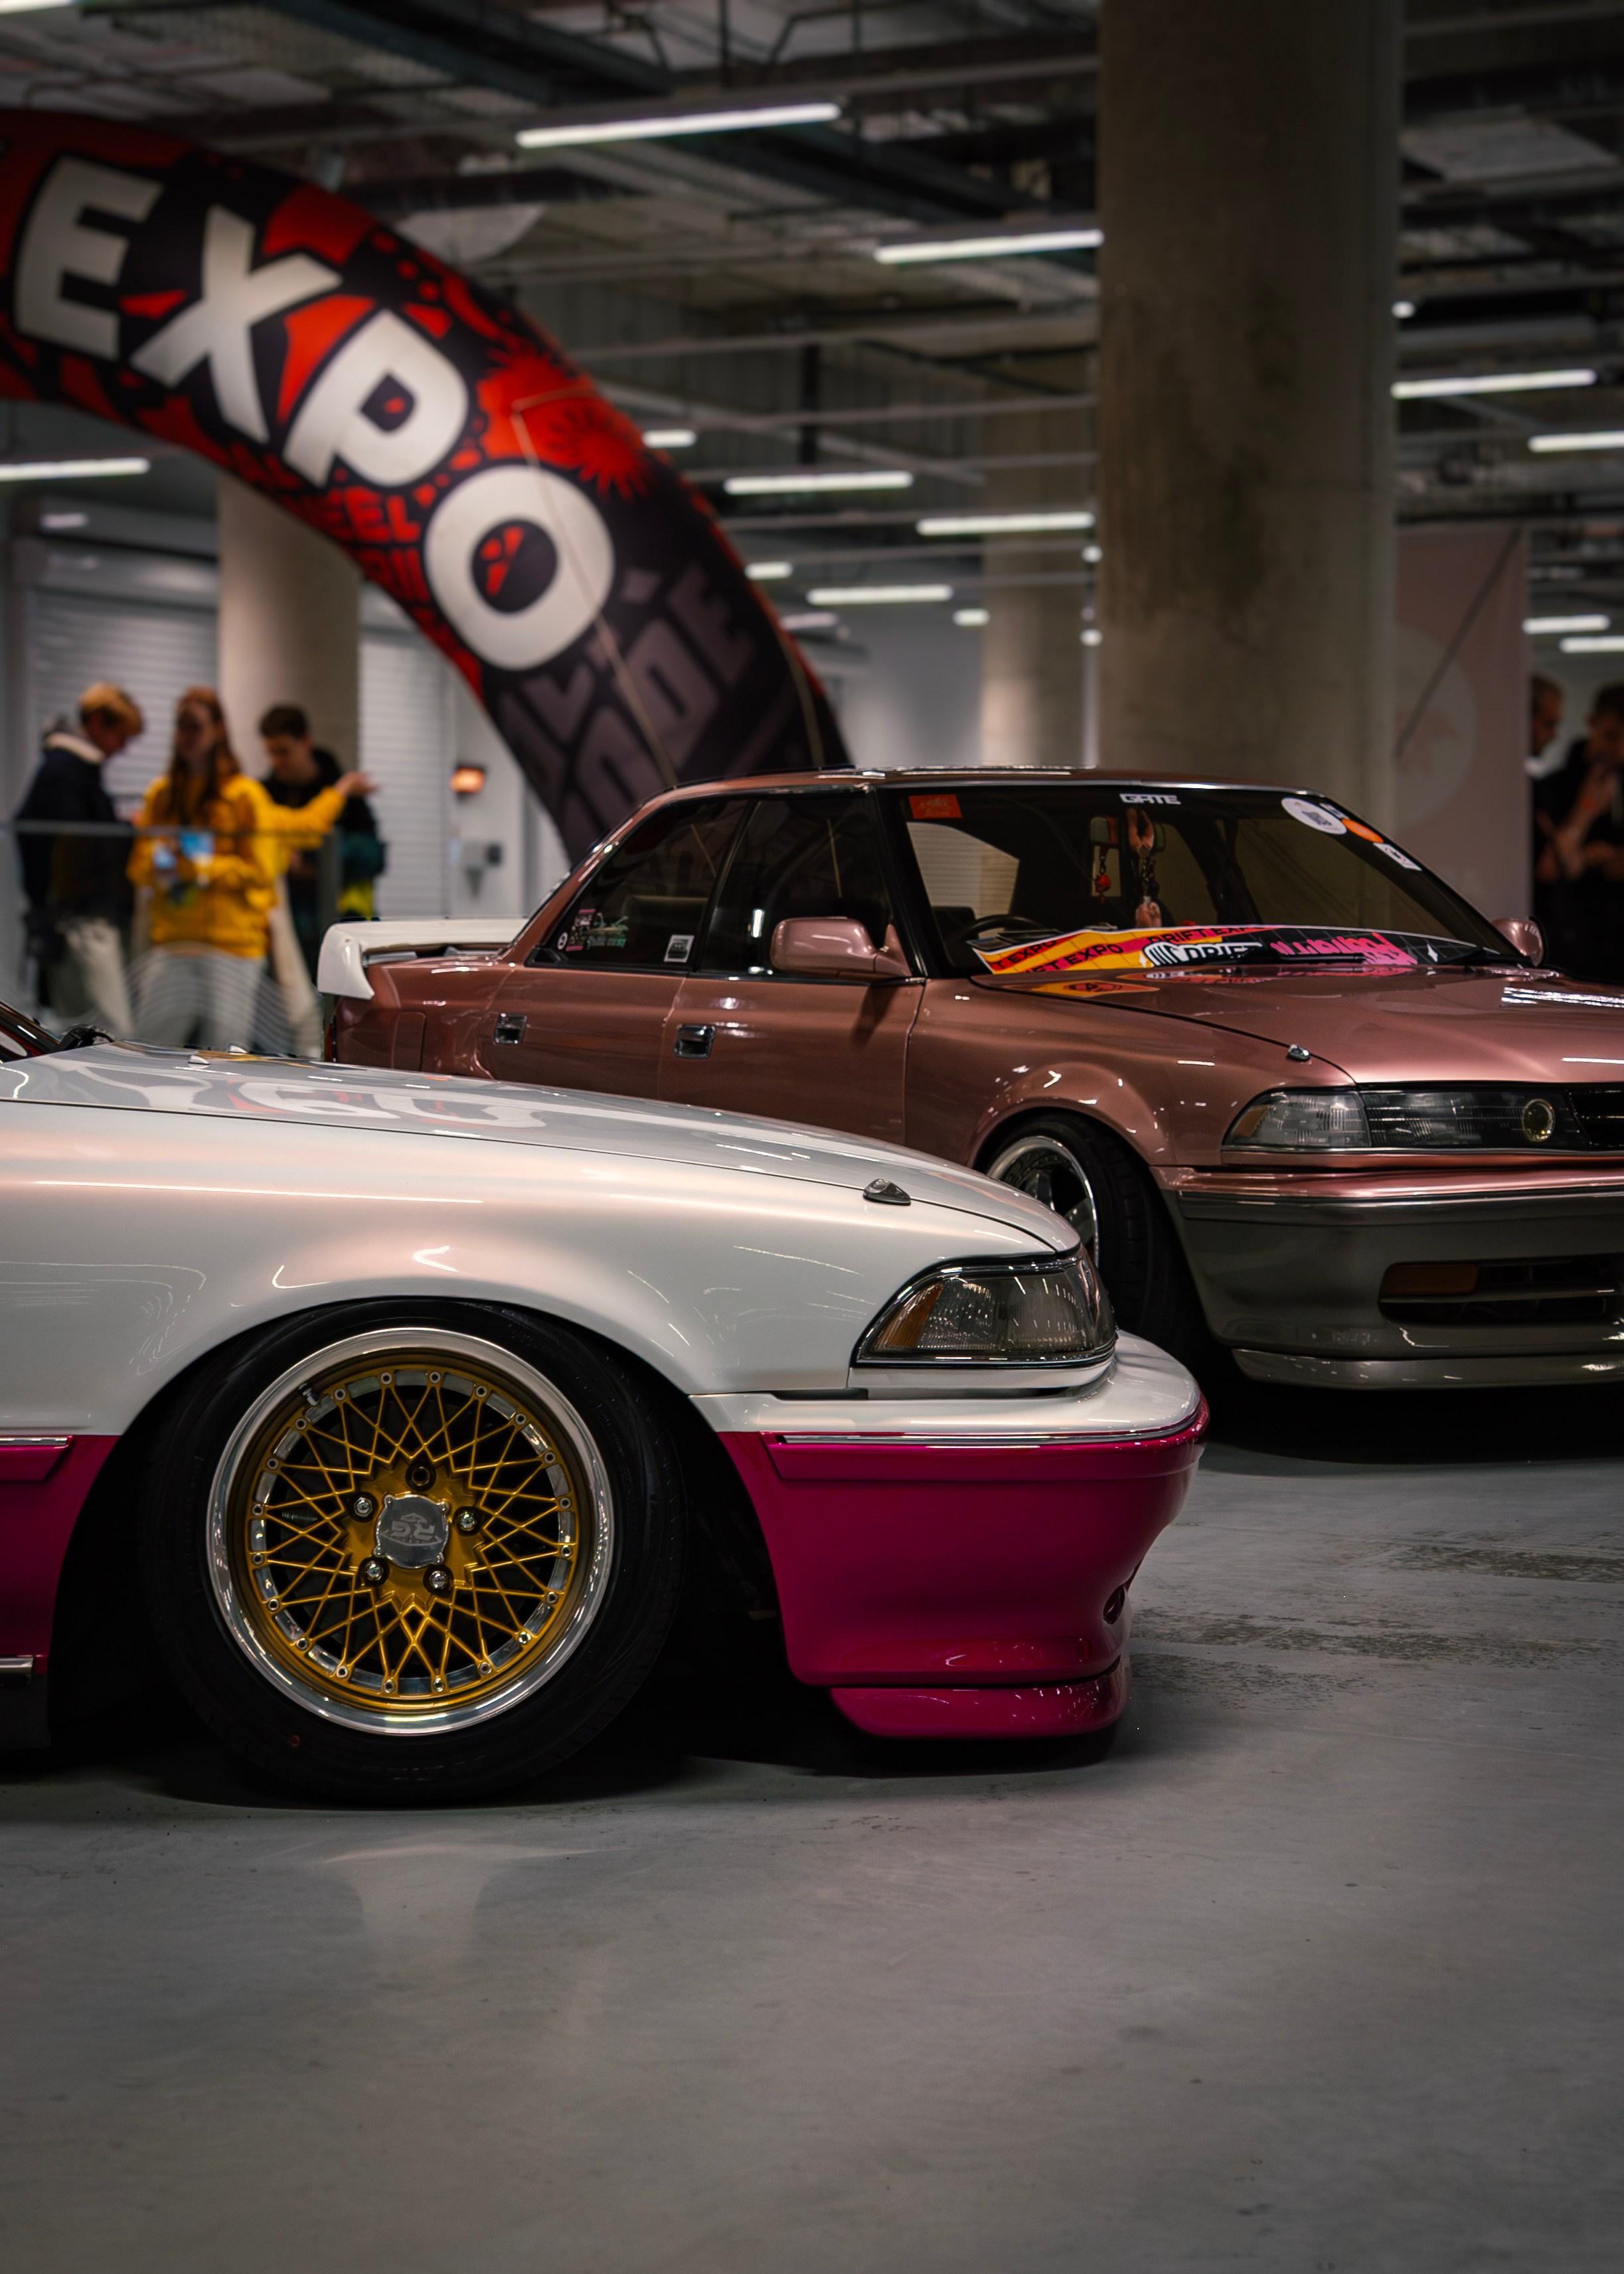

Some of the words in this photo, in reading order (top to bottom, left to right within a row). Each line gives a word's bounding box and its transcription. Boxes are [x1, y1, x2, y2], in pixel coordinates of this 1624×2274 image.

[15, 155, 615, 671] EXPO
[1119, 793, 1181, 805] GATE
[1007, 940, 1057, 964] EXPO
[1063, 943, 1124, 965] EXPO
[1149, 928, 1208, 943] DRIFT
